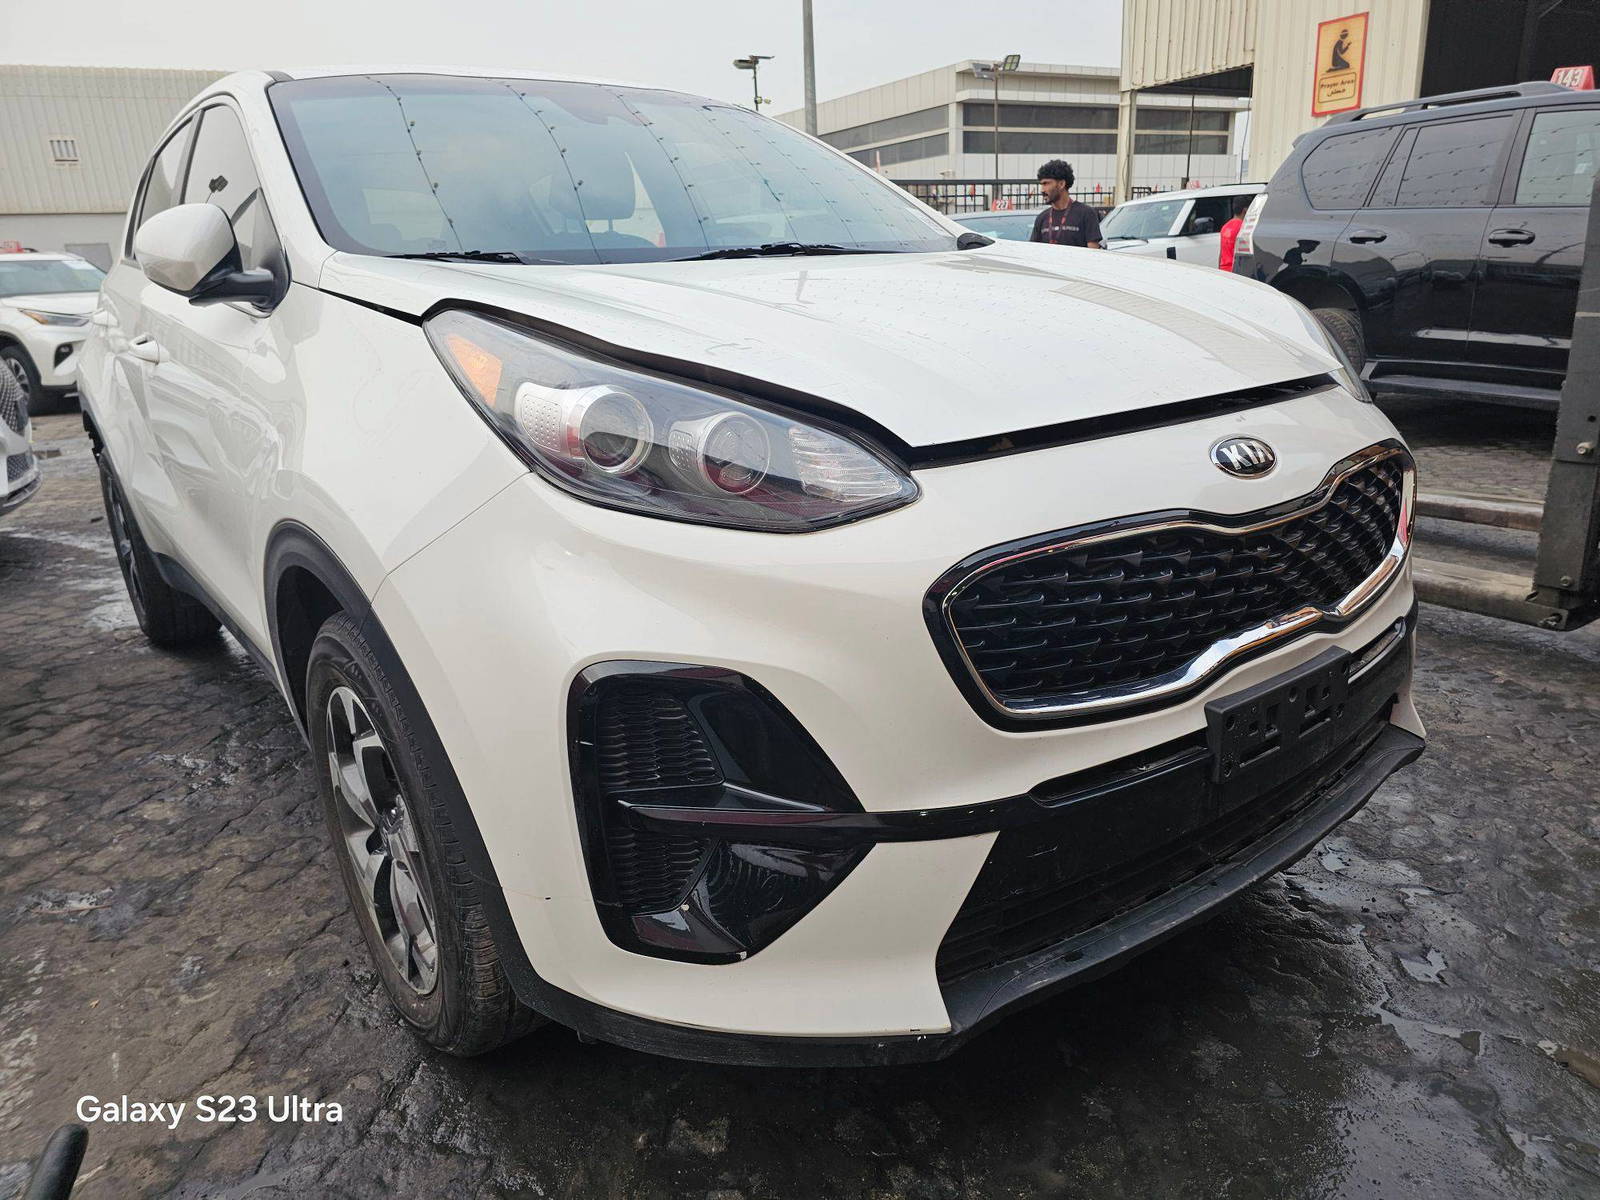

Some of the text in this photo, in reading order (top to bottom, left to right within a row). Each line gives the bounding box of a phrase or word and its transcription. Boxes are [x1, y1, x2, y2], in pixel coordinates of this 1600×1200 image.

[1320, 82, 1339, 90] Prayer
[1556, 69, 1584, 88] 143
[1219, 441, 1274, 470] KIA
